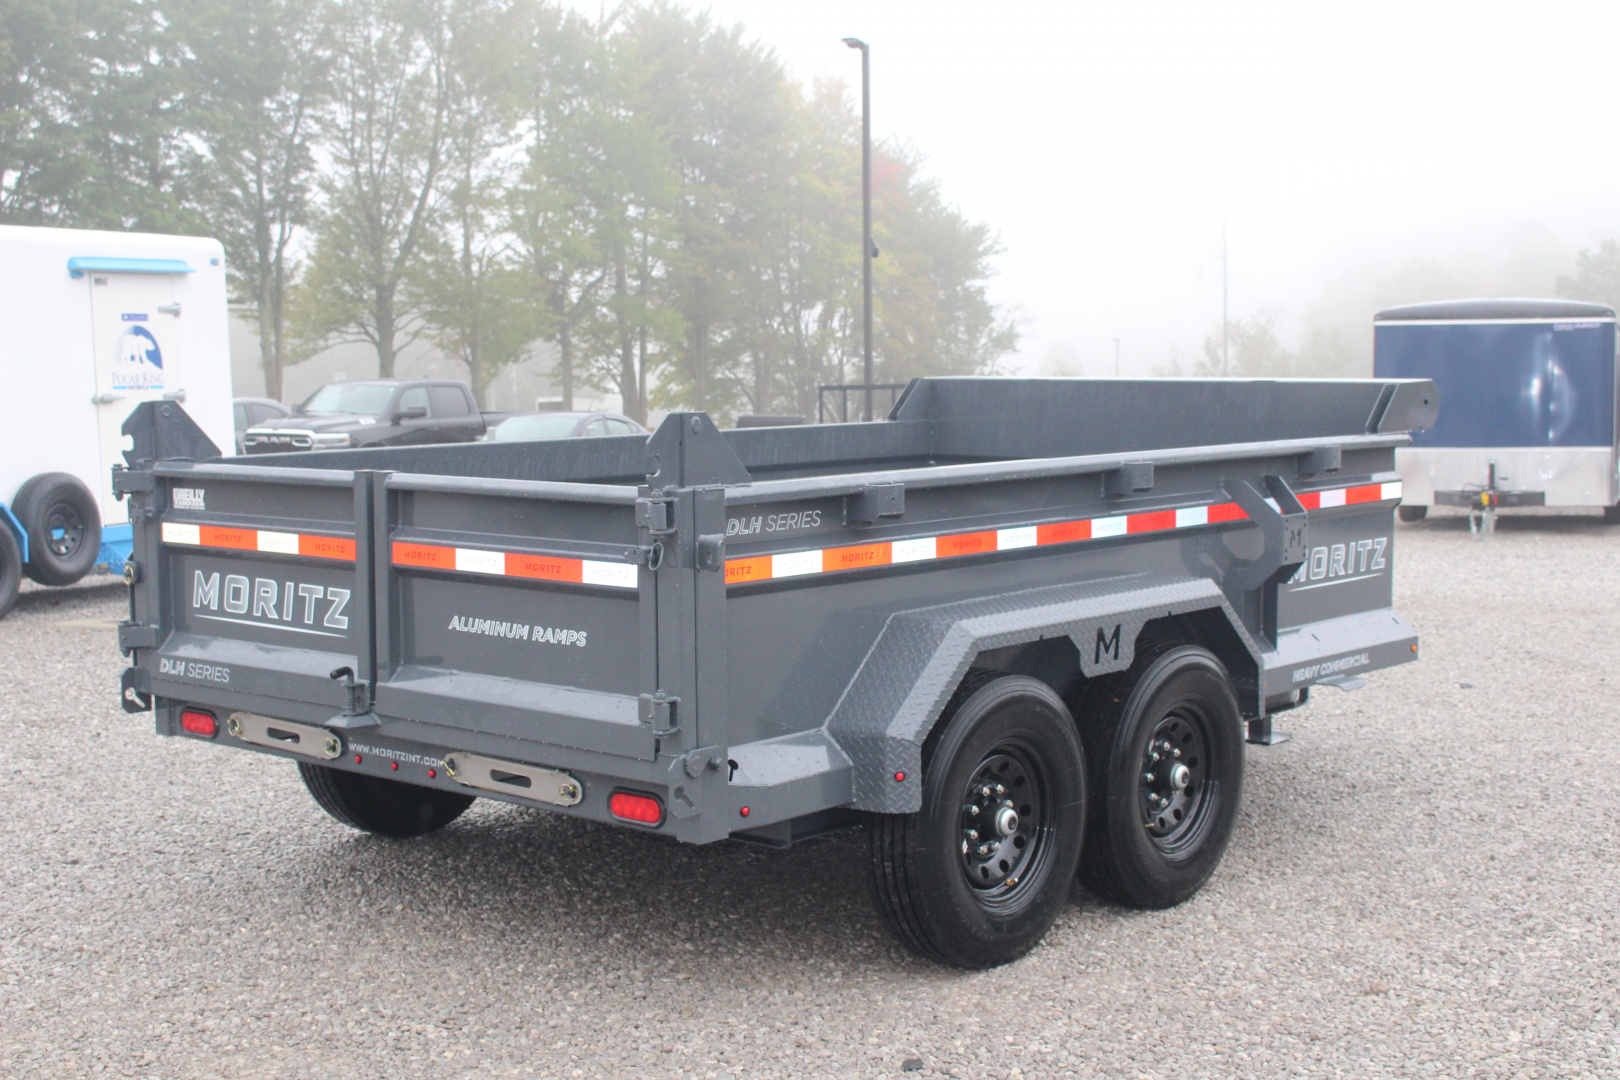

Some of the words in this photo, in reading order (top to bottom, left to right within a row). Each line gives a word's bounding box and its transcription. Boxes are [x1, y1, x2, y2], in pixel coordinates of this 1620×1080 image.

[112, 372, 140, 384] POLAR
[142, 372, 165, 384] KING
[726, 516, 763, 536] DLH
[765, 510, 822, 532] SERIES
[214, 533, 242, 543] MORITZ
[953, 538, 982, 549] MORITZ
[315, 542, 346, 554] MORITZ
[404, 550, 437, 561] MORITZ
[841, 551, 875, 563] MORITZ
[525, 562, 562, 574] MORITZ
[725, 565, 752, 577] ORITZ
[193, 570, 351, 630] MORITZ
[449, 615, 530, 640] ALUMINUM
[532, 626, 587, 647] RAMPS
[1094, 623, 1122, 665] M
[160, 658, 186, 676] DLH
[187, 663, 231, 683] SERIES
[1292, 664, 1320, 683] HEAVY
[1320, 652, 1370, 675] COMMERCIAL
